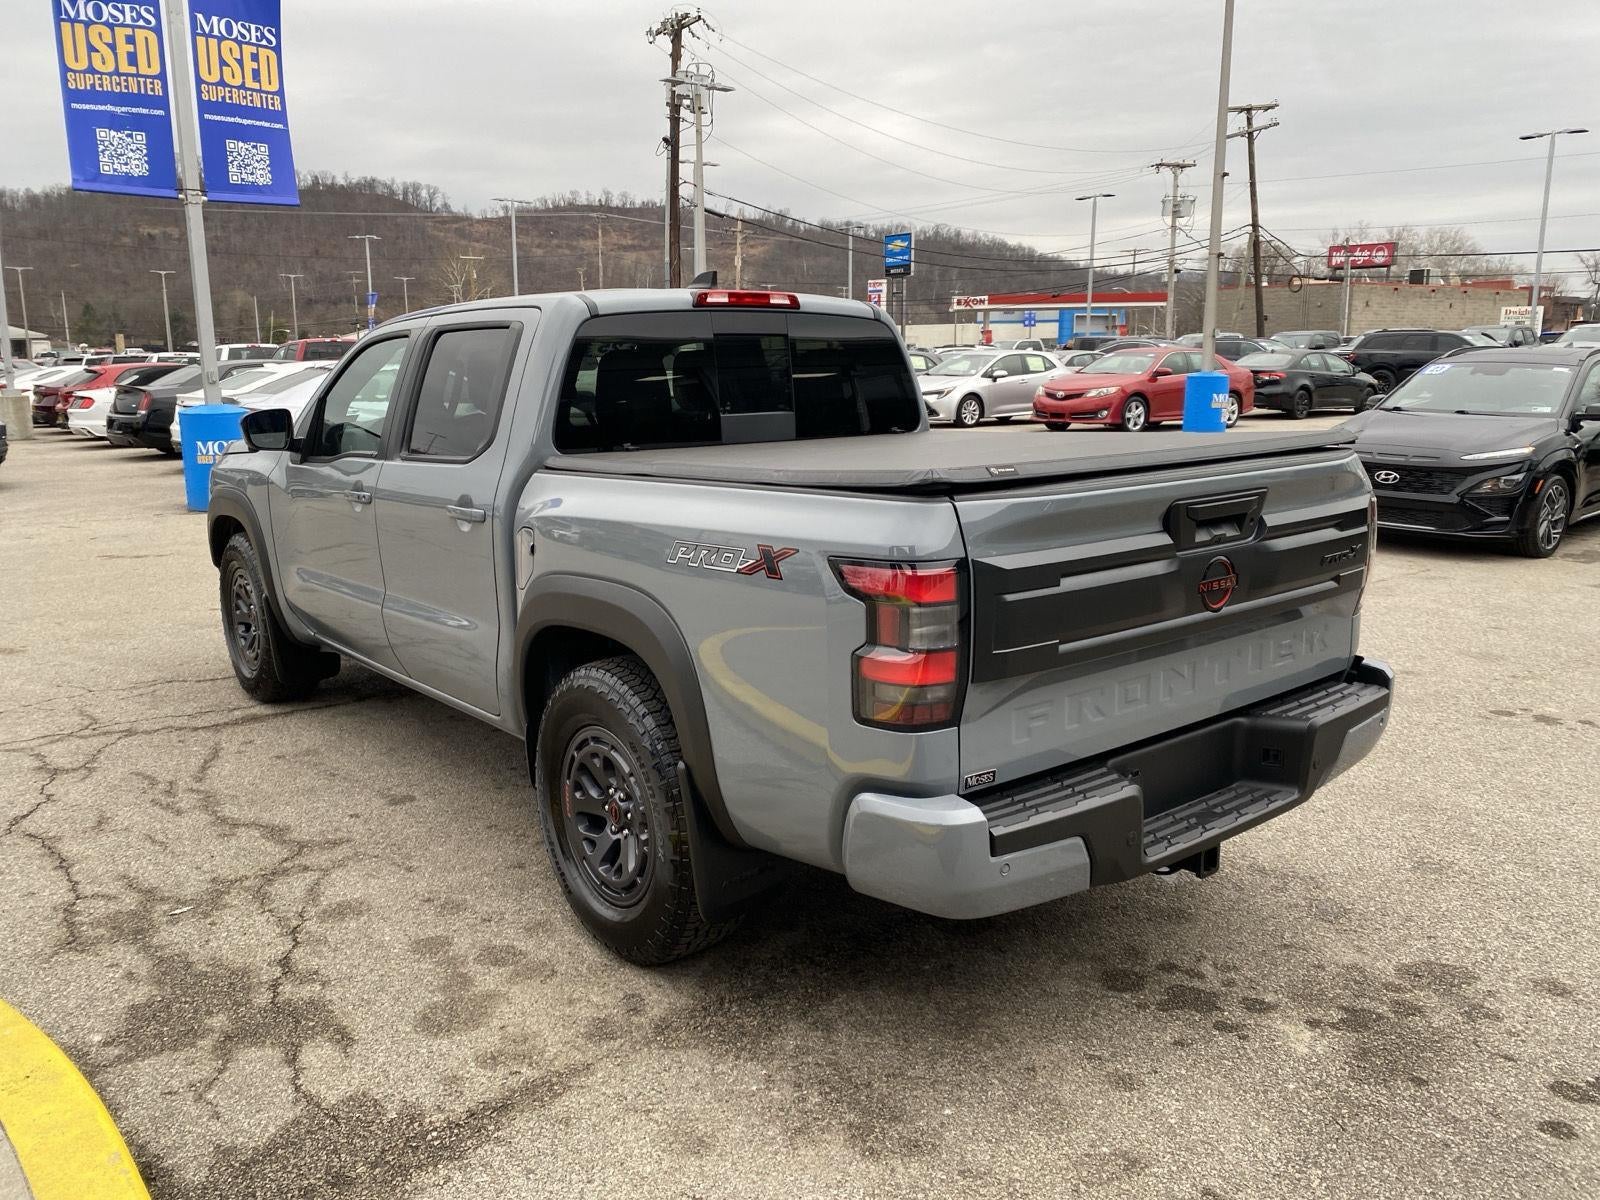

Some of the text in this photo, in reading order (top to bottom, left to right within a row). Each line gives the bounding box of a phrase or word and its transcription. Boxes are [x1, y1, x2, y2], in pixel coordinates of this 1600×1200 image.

[60, 0, 157, 27] MOSES
[195, 12, 277, 47] MOSES
[60, 22, 162, 76] USED
[196, 36, 280, 92] USED
[67, 72, 163, 96] SUPERCENTER
[201, 84, 282, 111] SUPERCENTER
[71, 102, 165, 116] mosesusedsupercenter.com
[204, 113, 285, 129] mosesusedsupercenter.com
[1332, 247, 1371, 266] Wndy's
[956, 296, 986, 309] EXXON
[1212, 393, 1230, 403] MO
[196, 440, 228, 456] MO
[1199, 574, 1238, 593] NISSAN
[1010, 626, 1330, 746] FRONTIER
[966, 771, 995, 788] MOSES
